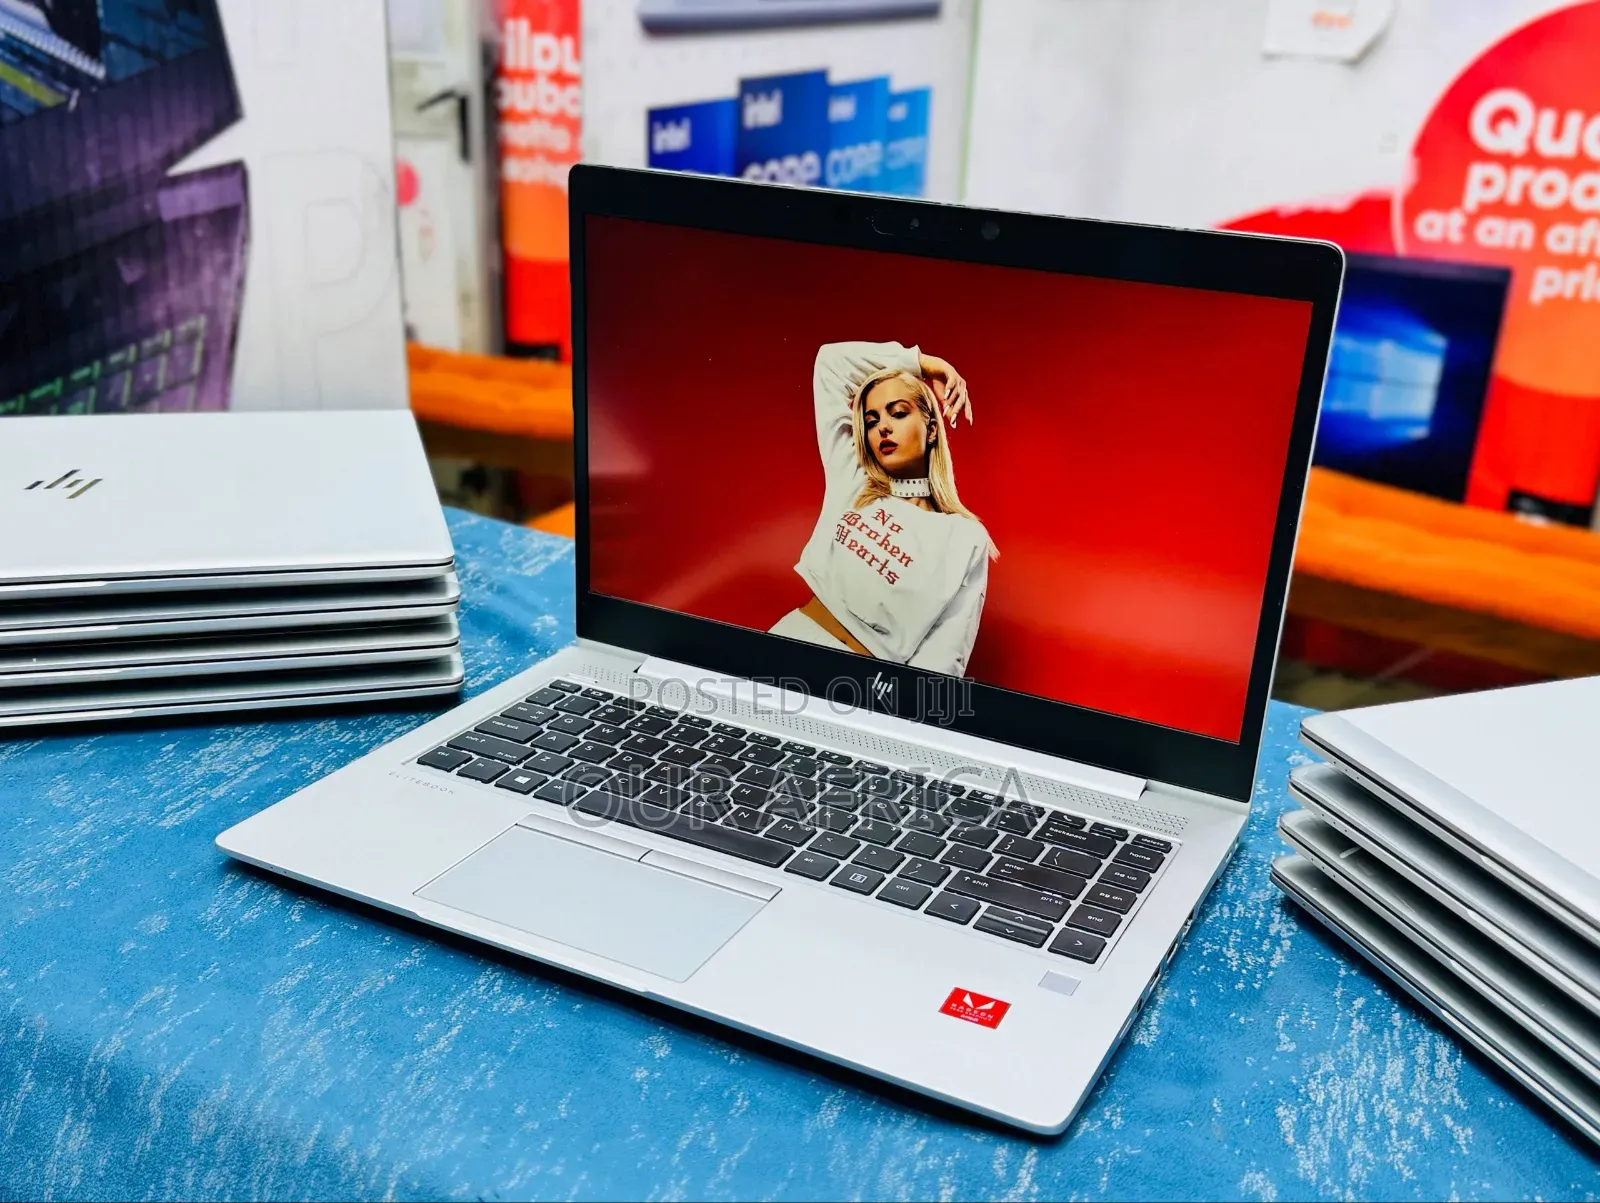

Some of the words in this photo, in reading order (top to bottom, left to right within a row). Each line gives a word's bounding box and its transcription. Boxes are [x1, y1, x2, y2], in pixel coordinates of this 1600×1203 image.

[742, 88, 782, 131] intel
[652, 118, 692, 155] intel
[1413, 207, 1467, 244] at
[1473, 216, 1536, 251] an
[1529, 261, 1600, 308] pri
[871, 508, 904, 535] No
[840, 511, 914, 568] Broken
[835, 523, 900, 585] Hearts
[388, 771, 456, 795] ELITEBOOK
[1049, 826, 1087, 841] backspace
[1004, 863, 1025, 871] enter
[1129, 851, 1151, 861] home
[972, 879, 989, 888] shift
[1087, 914, 1104, 923] end
[950, 1003, 995, 1020] RADEON
